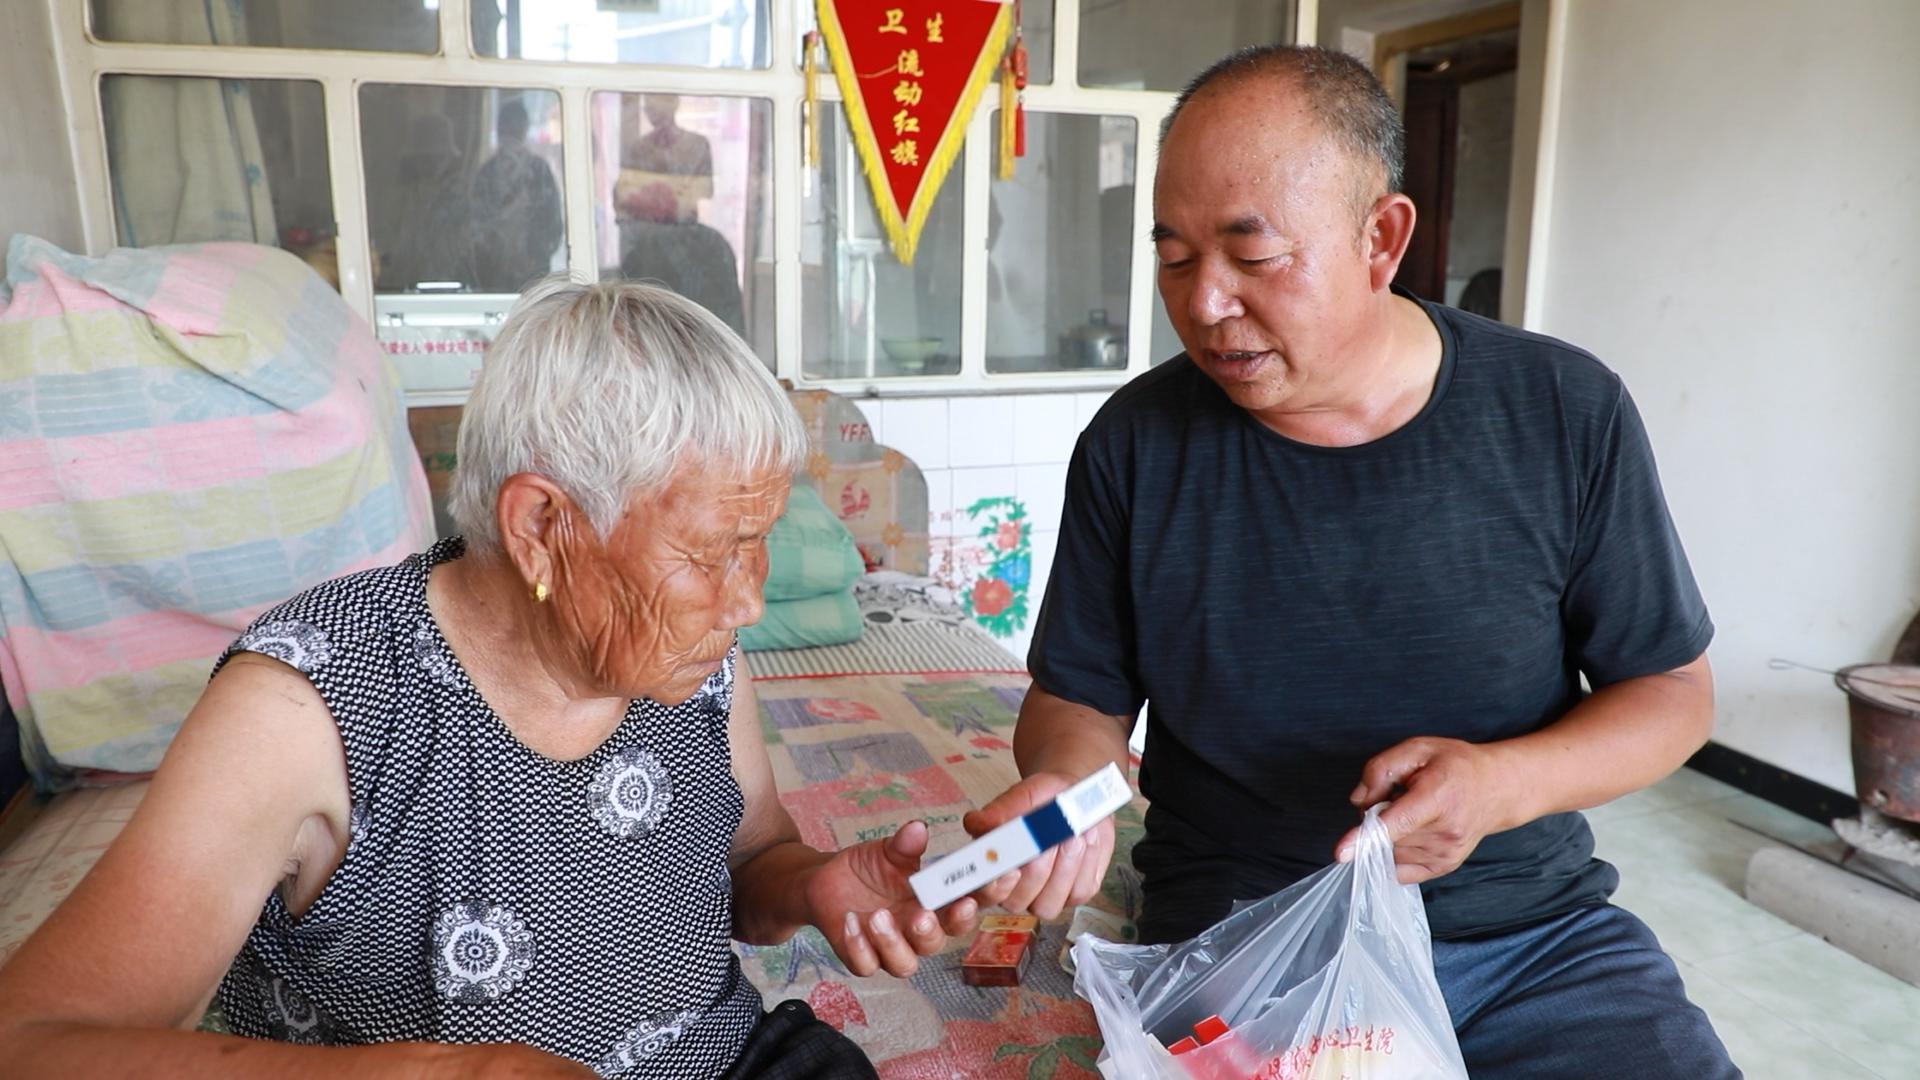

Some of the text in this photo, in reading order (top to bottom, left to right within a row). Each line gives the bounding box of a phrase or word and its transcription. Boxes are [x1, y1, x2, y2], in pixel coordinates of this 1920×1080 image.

[878, 9, 943, 43] 卫生
[890, 49, 924, 167] 流动红旗
